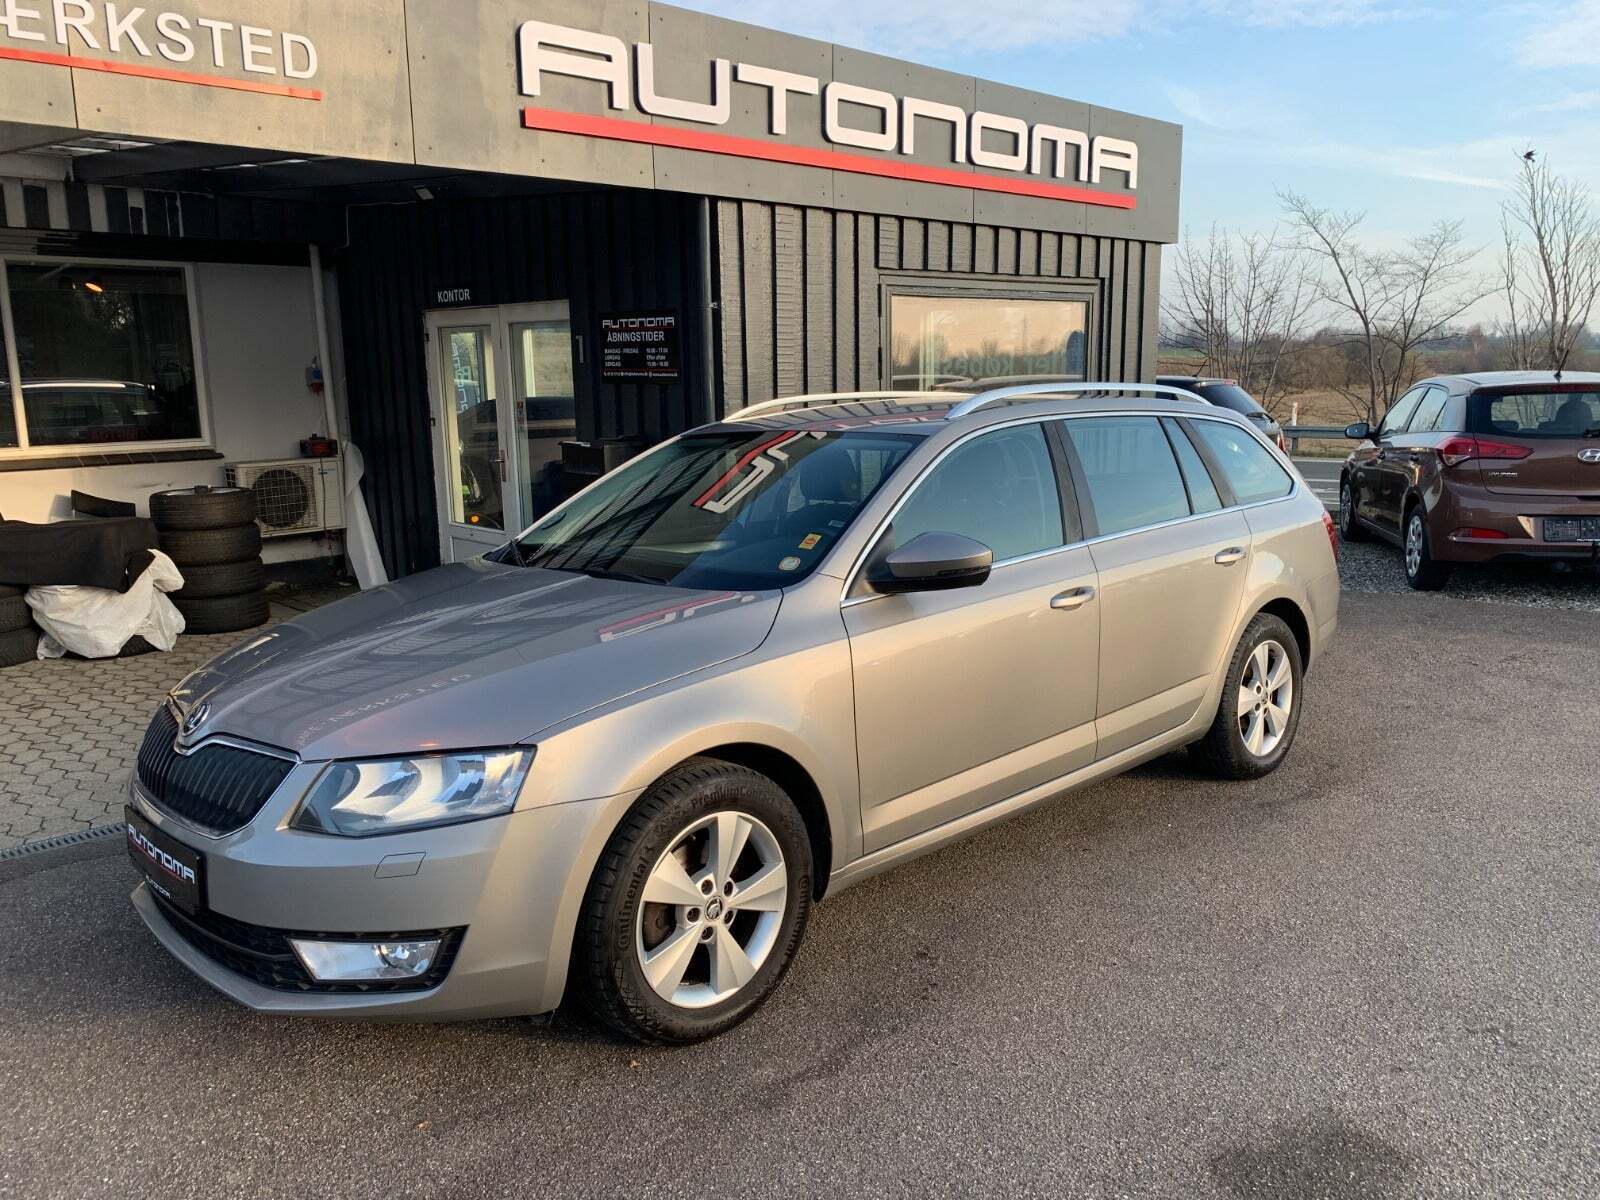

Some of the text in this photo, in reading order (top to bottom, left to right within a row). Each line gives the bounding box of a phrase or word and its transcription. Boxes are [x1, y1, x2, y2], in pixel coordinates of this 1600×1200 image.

[518, 20, 1139, 189] AUTONOMA
[437, 289, 471, 303] KONTOR
[602, 316, 675, 329] AUTONOMA
[607, 331, 665, 343] ÅBNINGSTIDER
[128, 824, 195, 884] AUTONOMA
